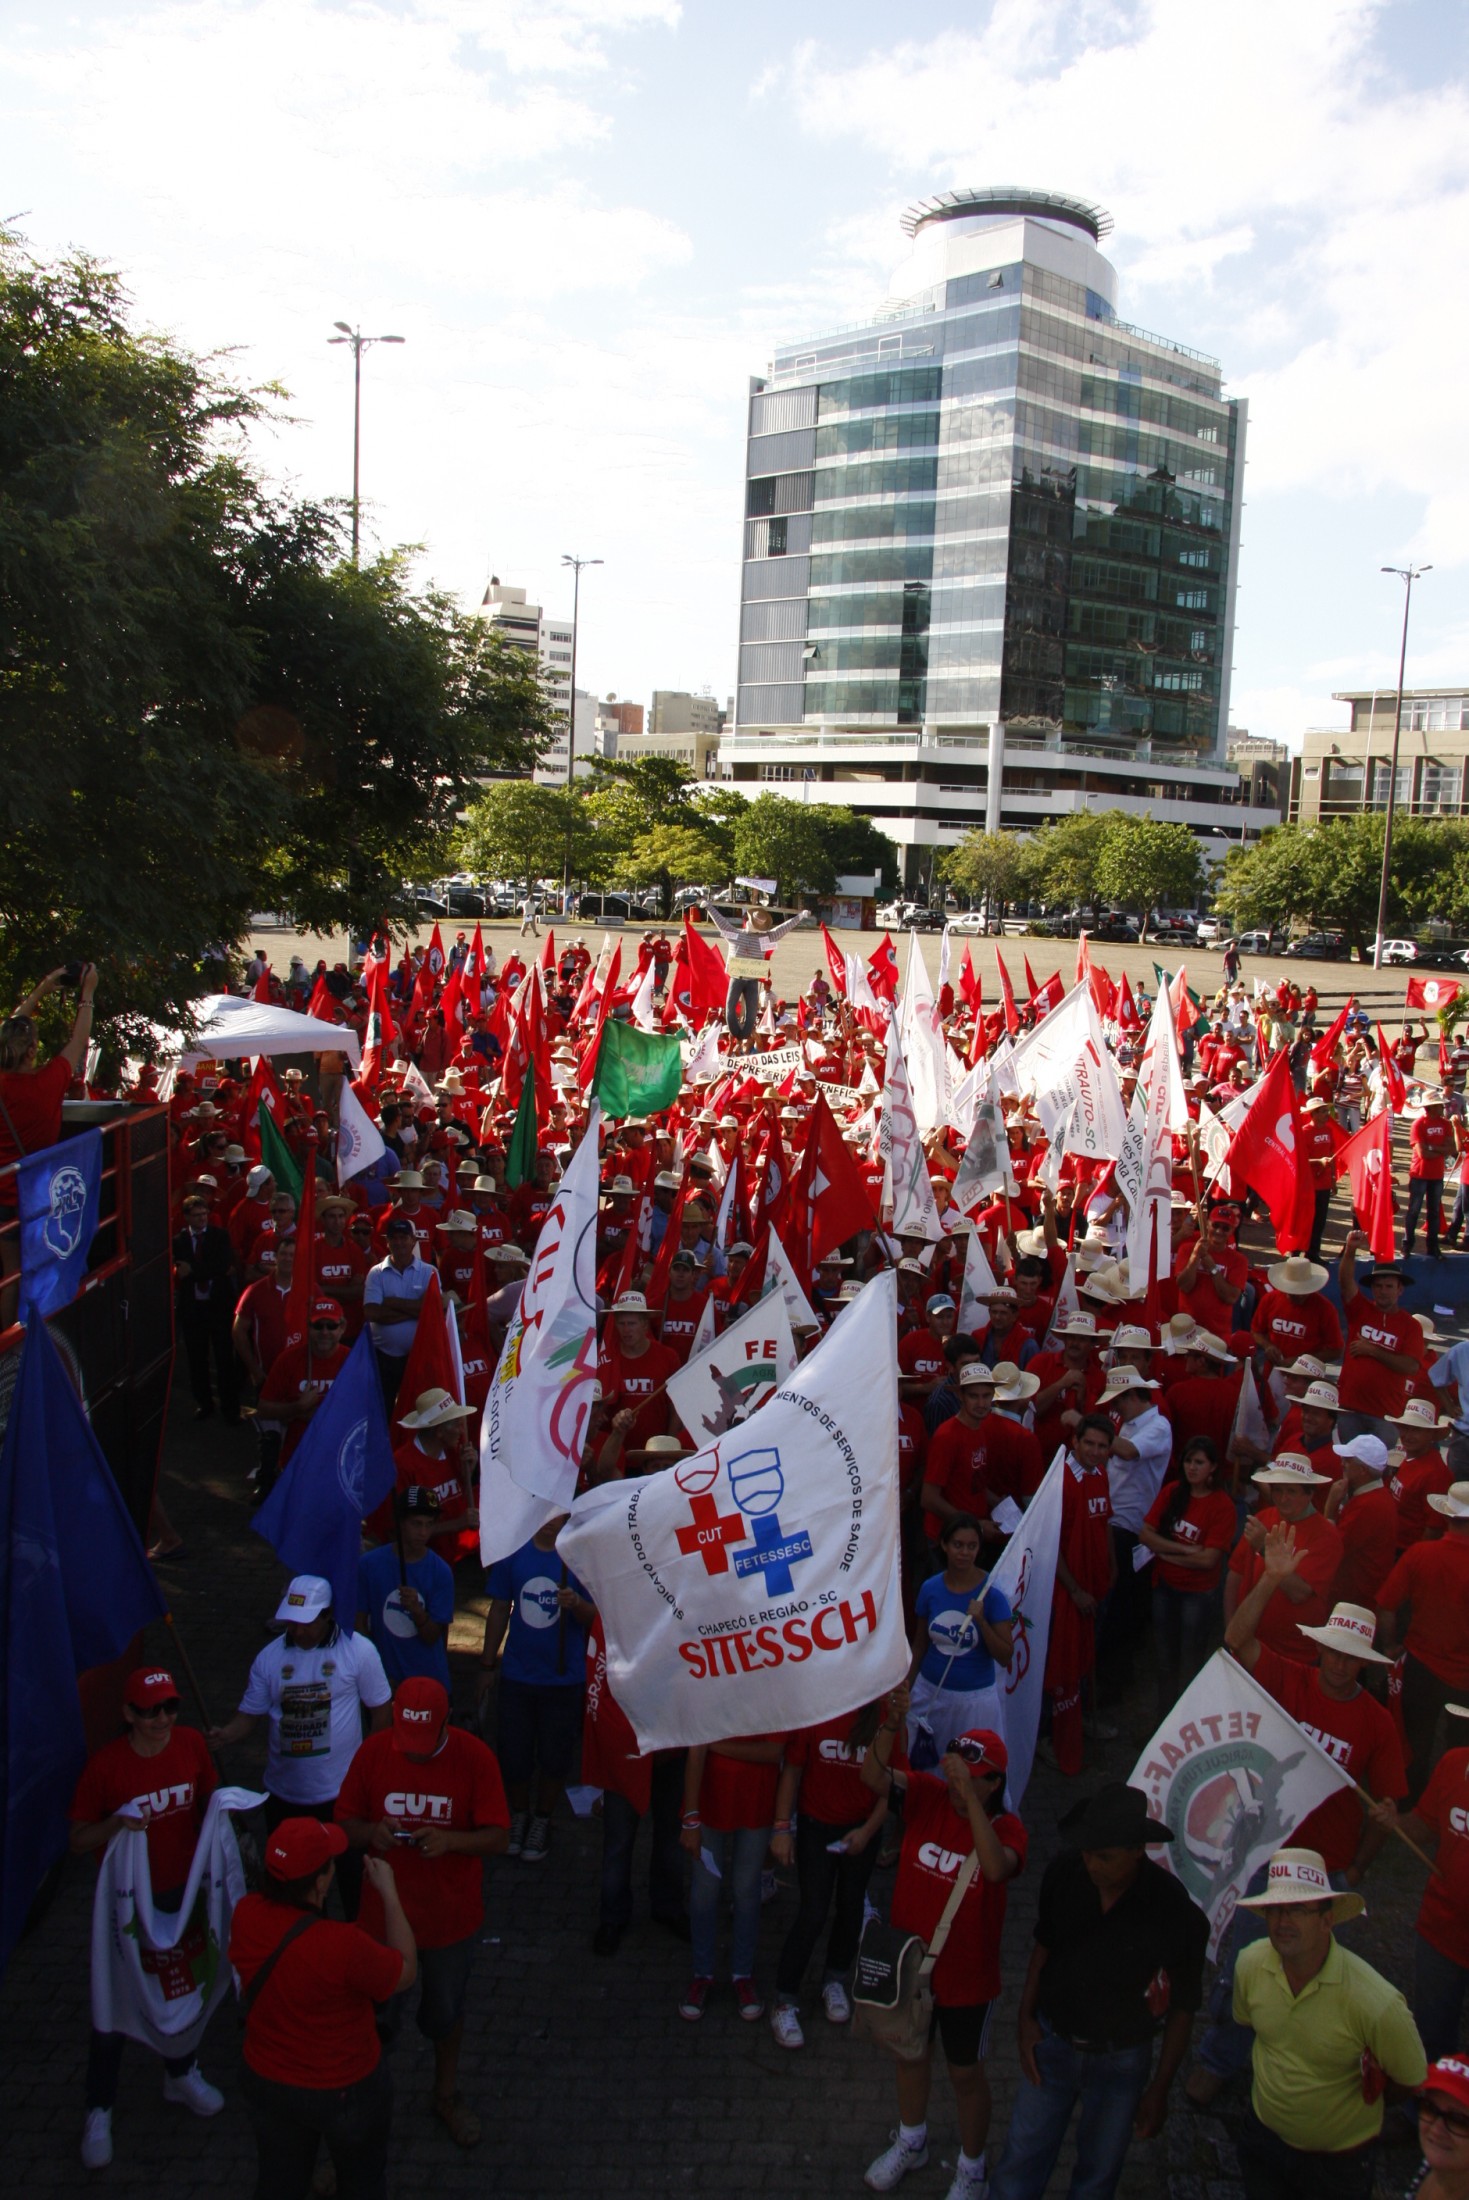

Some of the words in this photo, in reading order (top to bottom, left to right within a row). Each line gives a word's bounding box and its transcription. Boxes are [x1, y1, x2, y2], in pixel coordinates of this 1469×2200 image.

[727, 1058, 739, 1070] DE
[761, 1055, 779, 1065] DAS
[781, 1050, 800, 1063] LEIS
[1314, 1134, 1330, 1142] CUT
[1427, 1127, 1443, 1135] CUT
[1264, 1136, 1286, 1158] CENTRAL
[531, 1203, 549, 1212] CU
[321, 1265, 350, 1277] CUT
[455, 1269, 473, 1279] CU
[664, 1321, 694, 1333] CUT
[1272, 1318, 1303, 1335] CUT
[1361, 1325, 1397, 1346] CUT
[463, 1361, 487, 1376] UT
[624, 1379, 651, 1392] UT
[819, 1414, 837, 1432] DE
[832, 1428, 863, 1496] SERVIÇOS
[852, 1498, 863, 1519] DE
[1088, 1498, 1106, 1513] UT
[697, 1526, 722, 1544] CUT
[1174, 1520, 1197, 1538] UT
[631, 1533, 647, 1560] DOS
[839, 1522, 862, 1573] SAÚDE
[735, 1539, 811, 1572] FETESSESC
[698, 1615, 748, 1636] CHAPECÓ
[749, 1614, 757, 1625] E
[760, 1600, 809, 1621] REGIÃO
[819, 1590, 838, 1604] SC
[678, 1589, 877, 1679] SITESSCH
[144, 1673, 169, 1685] CUT
[402, 1708, 430, 1721] CUT
[384, 1792, 448, 1817] CUT
[275, 1848, 287, 1858] CUT
[1298, 1867, 1325, 1886] CUT
